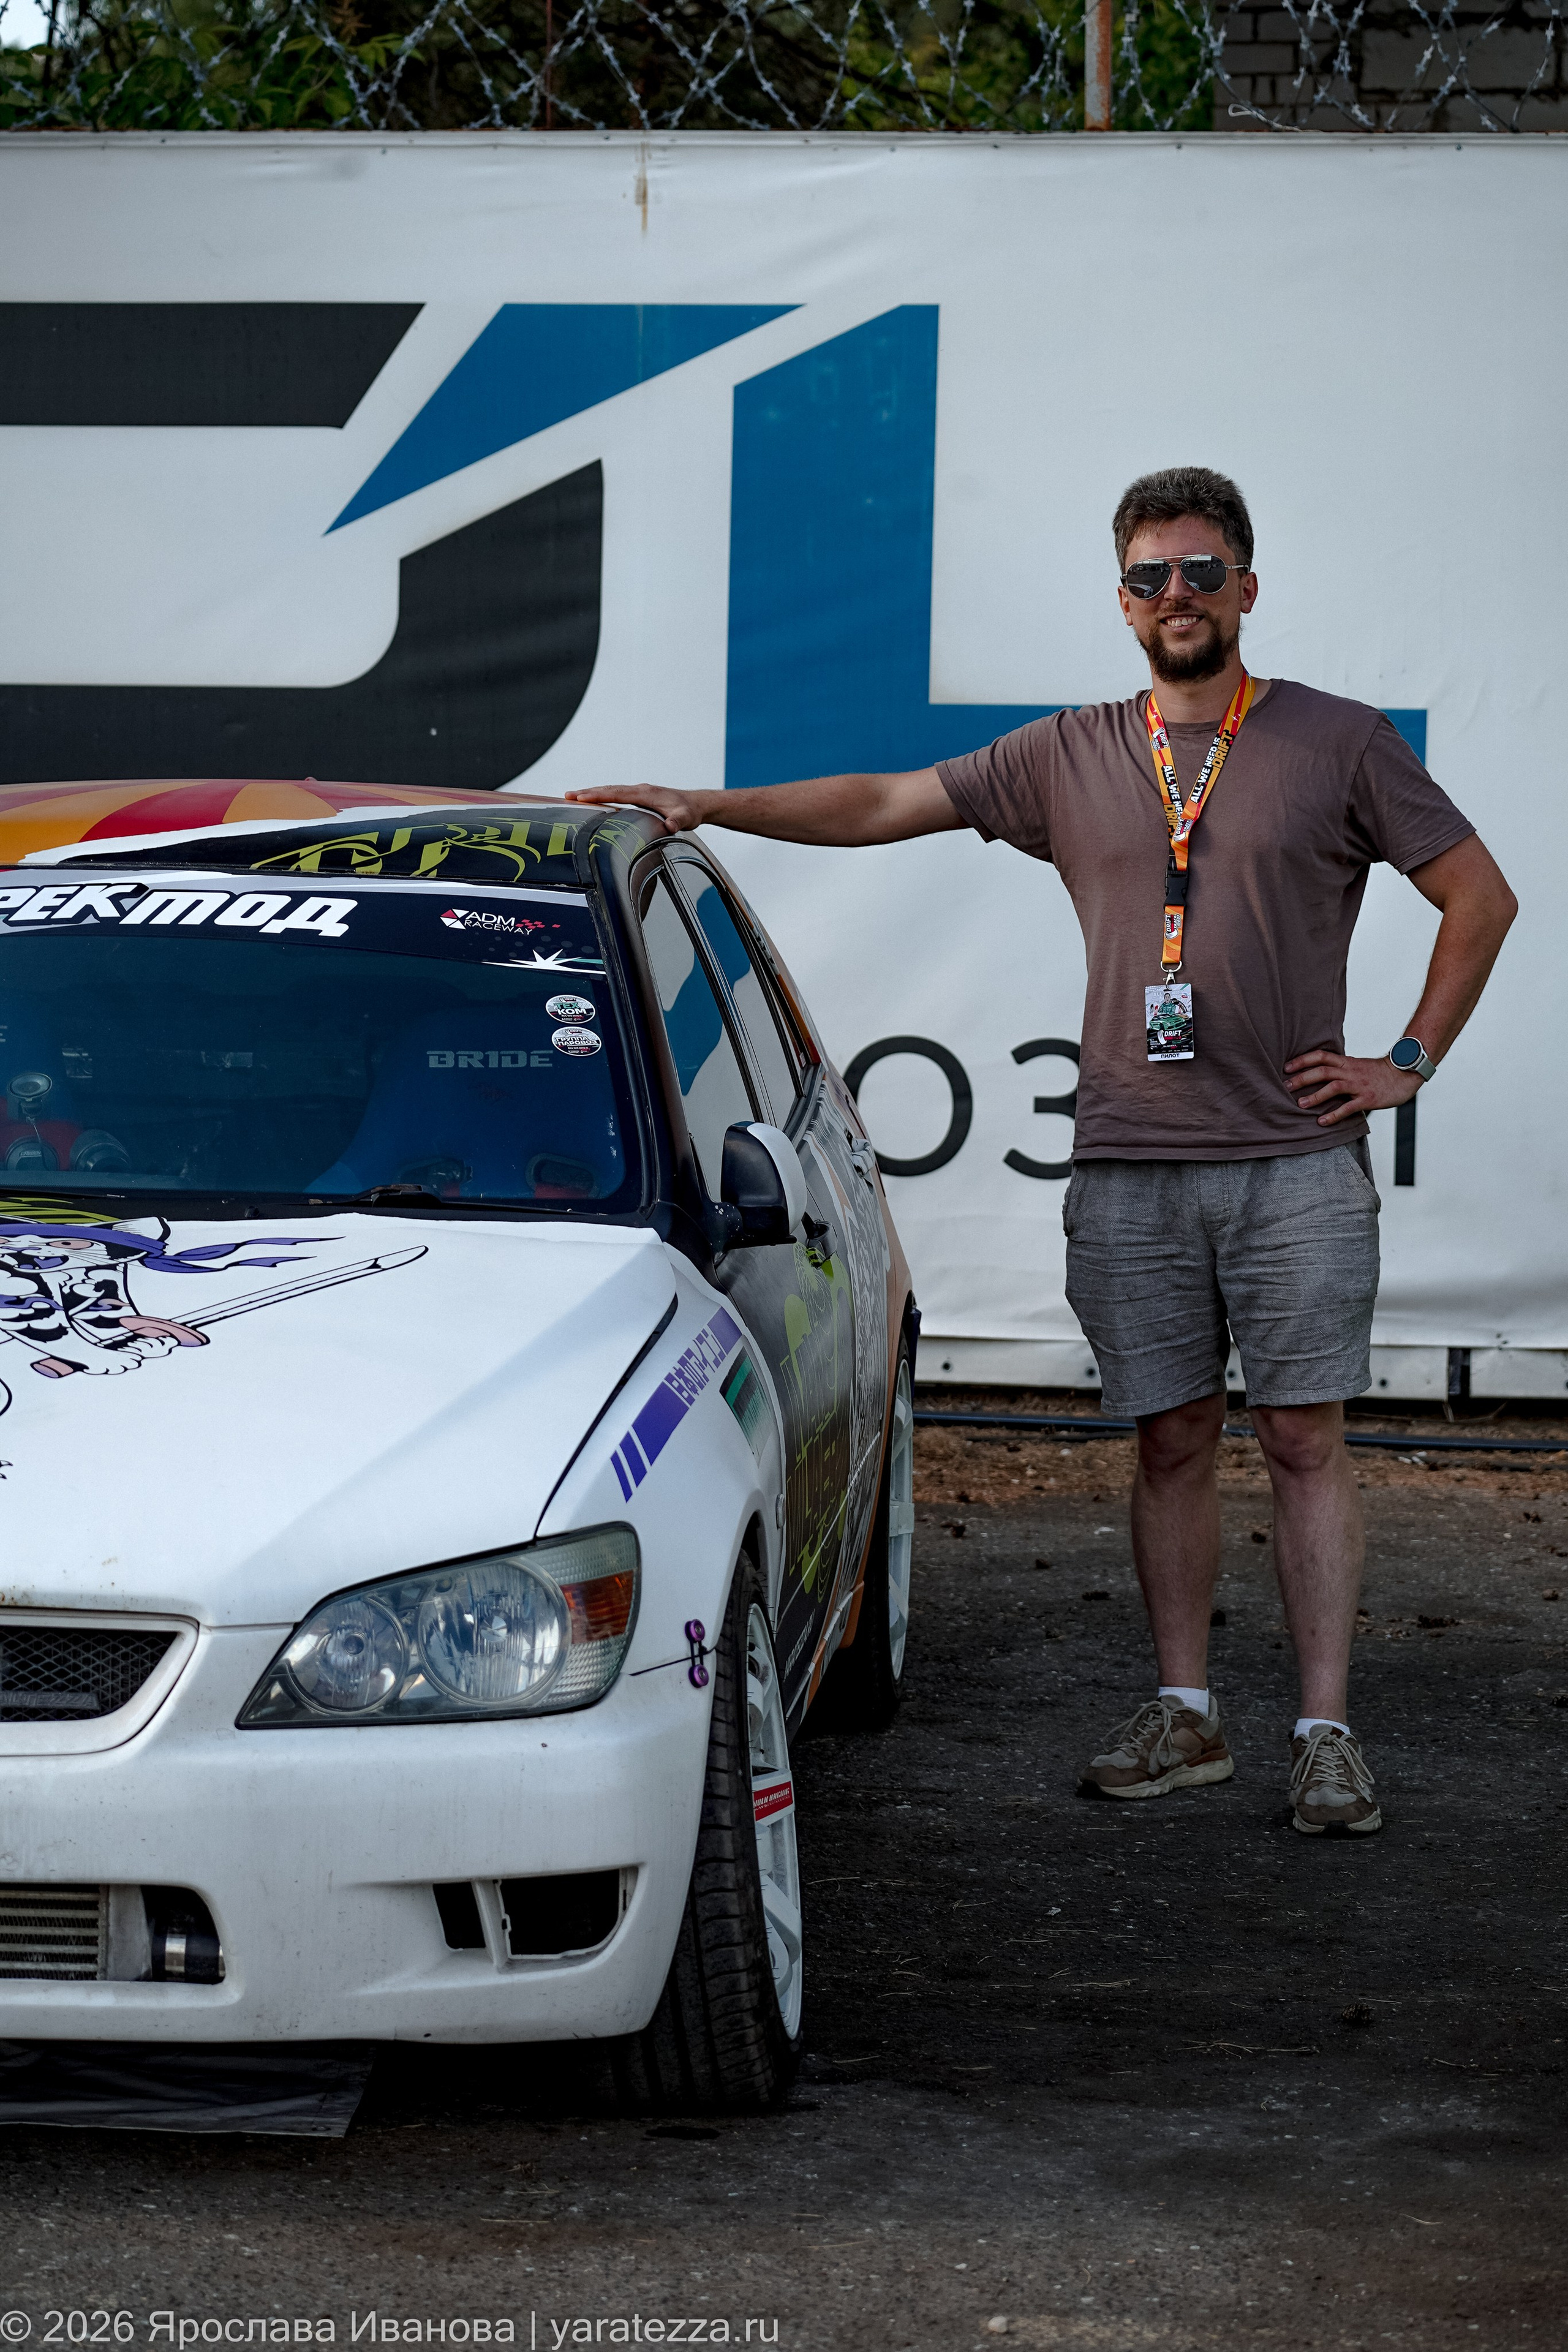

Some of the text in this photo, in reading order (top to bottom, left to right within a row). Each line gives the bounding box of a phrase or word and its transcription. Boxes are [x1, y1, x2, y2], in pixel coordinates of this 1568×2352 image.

[1212, 731, 1232, 769] DRIFT
[1164, 766, 1175, 783] ALL
[1190, 737, 1221, 803] ALL WE NEED IS
[1169, 783, 1180, 800] WE
[464, 919, 533, 935] RACEWAY
[465, 911, 516, 927] ADM
[426, 1050, 554, 1068] BRIDE
